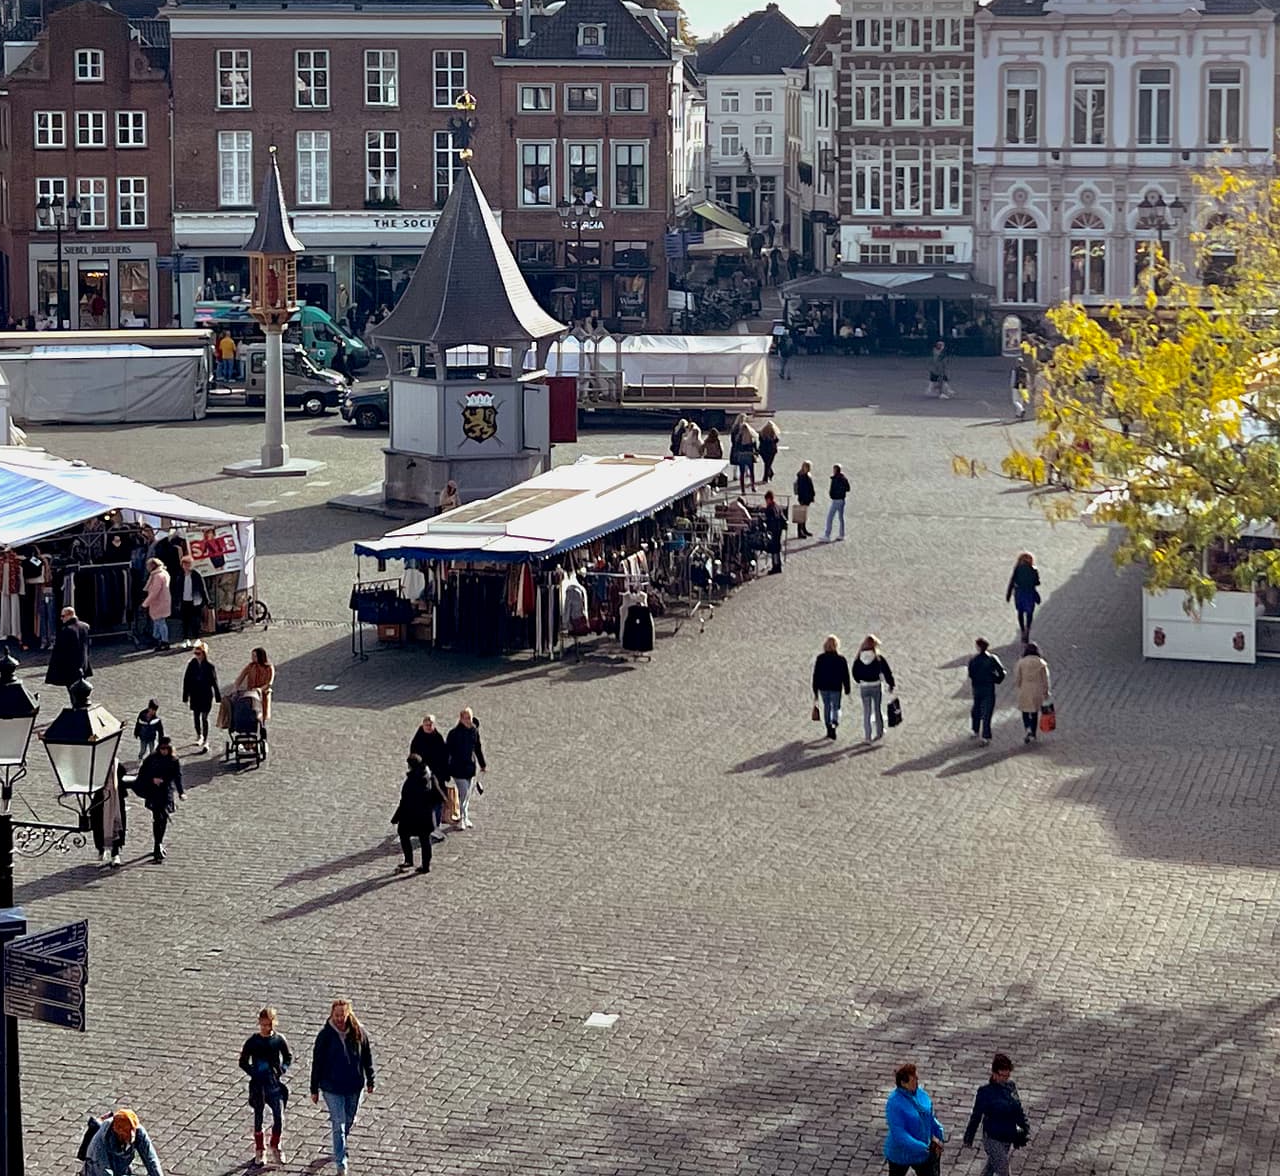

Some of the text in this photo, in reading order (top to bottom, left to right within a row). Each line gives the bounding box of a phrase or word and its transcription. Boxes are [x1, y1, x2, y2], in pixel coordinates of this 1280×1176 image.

[374, 219, 438, 228] THE SOCIE
[191, 536, 236, 558] SE
